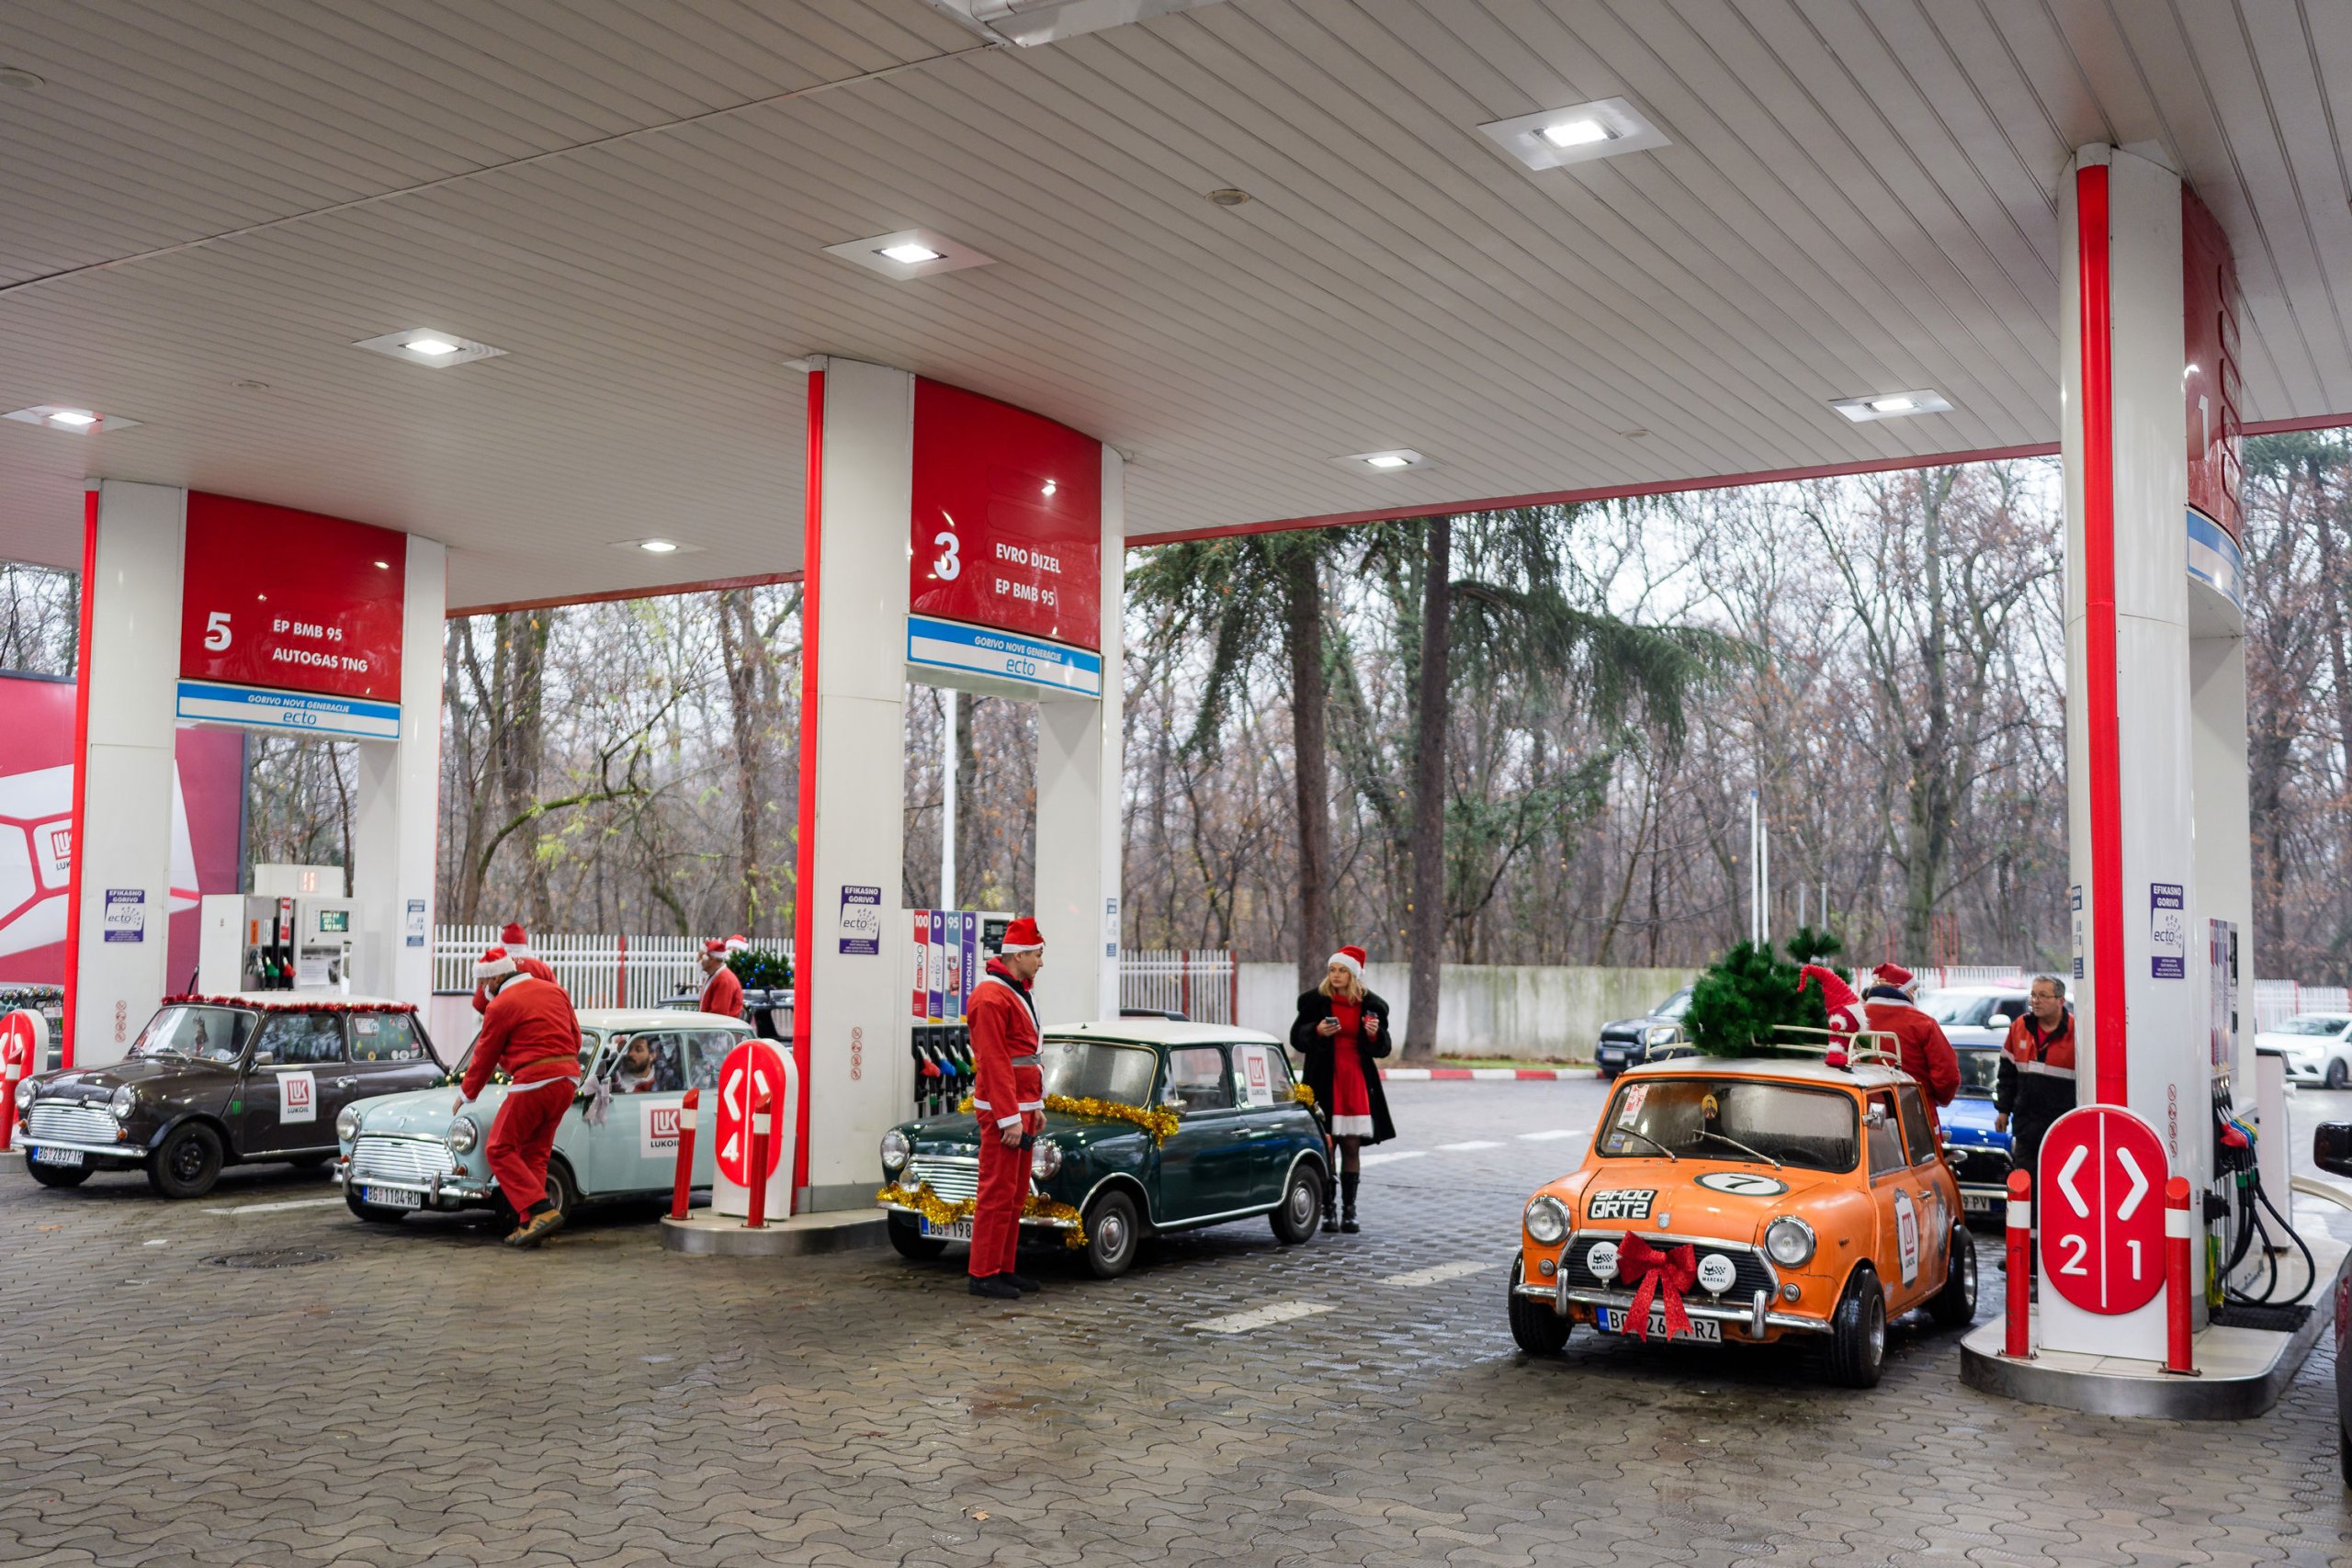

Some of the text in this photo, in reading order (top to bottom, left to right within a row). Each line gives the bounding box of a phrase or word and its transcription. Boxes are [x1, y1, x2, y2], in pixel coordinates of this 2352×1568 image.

[2198, 393, 2209, 461] 1
[933, 531, 961, 581] 3
[996, 543, 1061, 574] EVRO DIZEL
[995, 578, 1055, 606] EP BMB 95
[204, 611, 232, 652] 5
[273, 619, 343, 642] EP BMB 95
[974, 636, 1062, 662] GORIVO NOVE GENERACIJE
[272, 648, 368, 672] AUTOGAS TNG
[1006, 658, 1035, 676] ecto
[248, 694, 350, 713] GORIVO NOVE GENERACIJE
[283, 710, 317, 725] ecto
[845, 886, 878, 895] EFIKASNO
[2153, 886, 2182, 896] EFIKASNO
[2156, 897, 2179, 908] GORIVO
[108, 914, 131, 922] ecto
[842, 919, 867, 929] ecto
[914, 914, 928, 928] 100
[933, 915, 942, 929] D
[947, 916, 959, 929] 95
[965, 917, 973, 930] D
[2154, 929, 2175, 942] ecto
[288, 1081, 309, 1102] LUK
[653, 1111, 680, 1135] LUK
[720, 1132, 740, 1162] 4
[1724, 1175, 1765, 1190] 7
[368, 1187, 378, 1201] BG
[1590, 1201, 1648, 1219] QRT2
[2059, 1234, 2088, 1276] 2
[2126, 1239, 2142, 1280] 1
